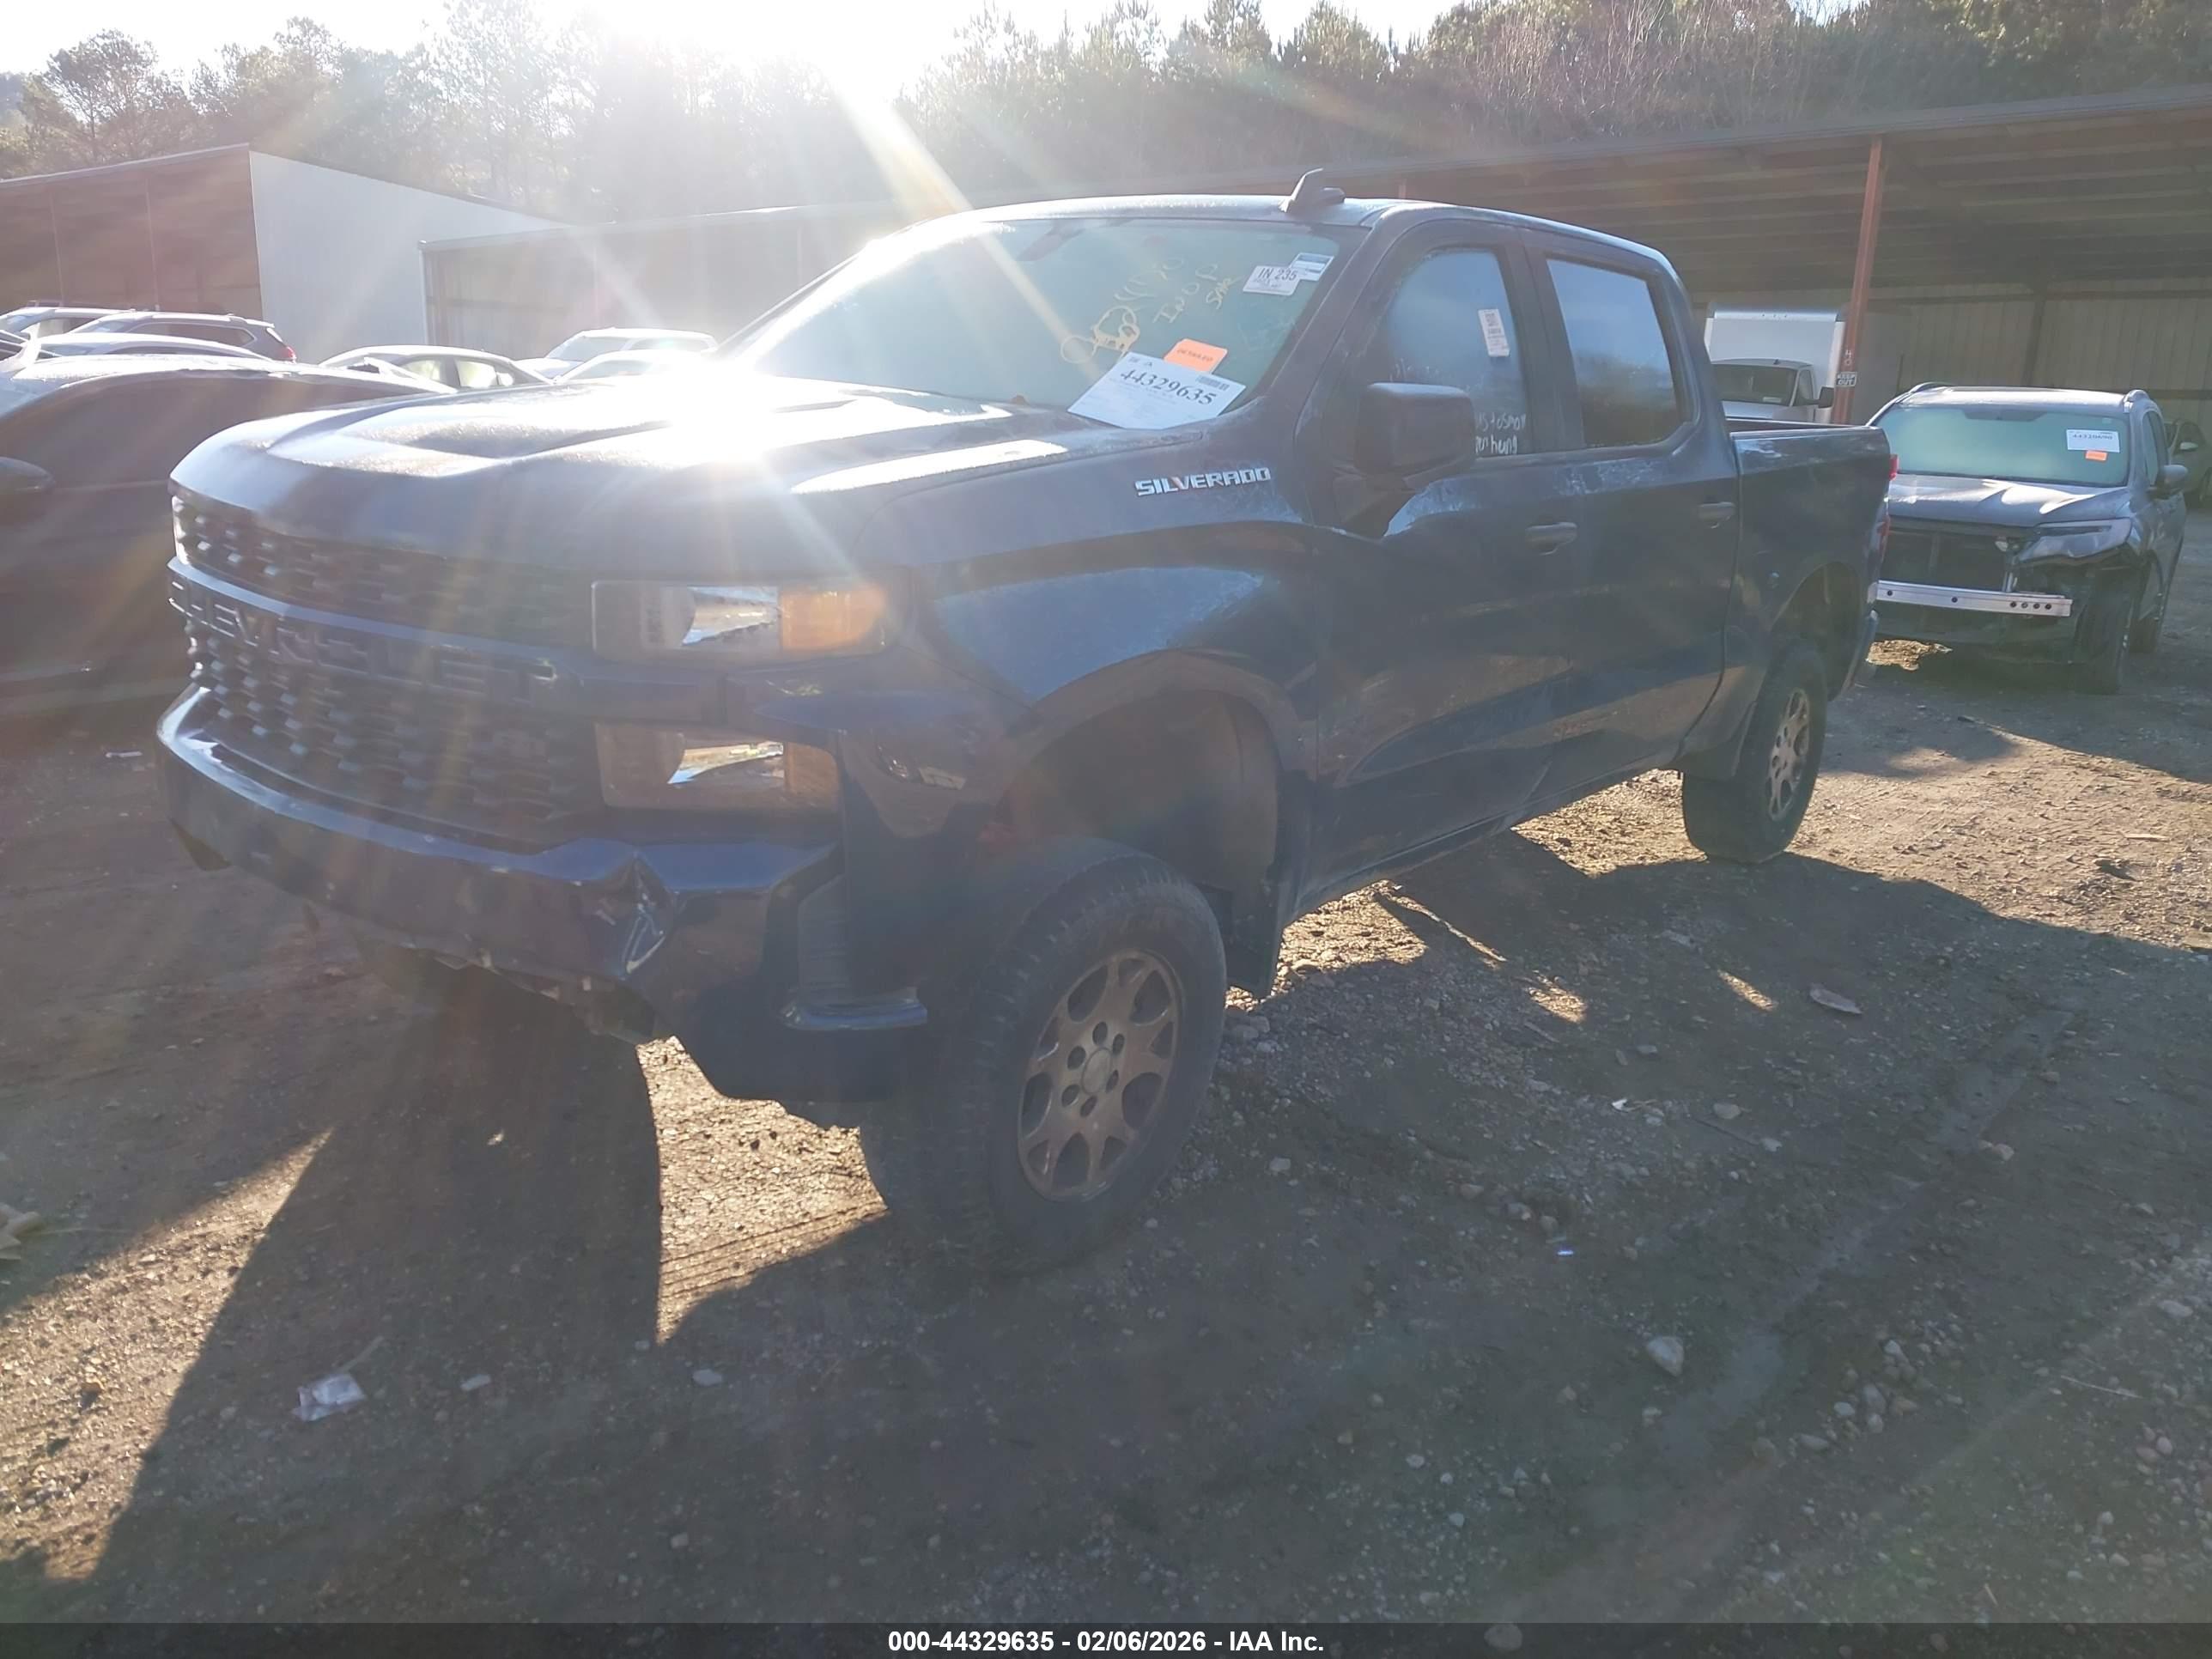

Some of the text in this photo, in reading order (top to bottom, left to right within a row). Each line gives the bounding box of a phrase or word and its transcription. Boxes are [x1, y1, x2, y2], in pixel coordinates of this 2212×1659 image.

[1257, 267, 1298, 281] IN 235
[1120, 368, 1218, 405] 44329635
[1134, 466, 1272, 496] SILVERADO
